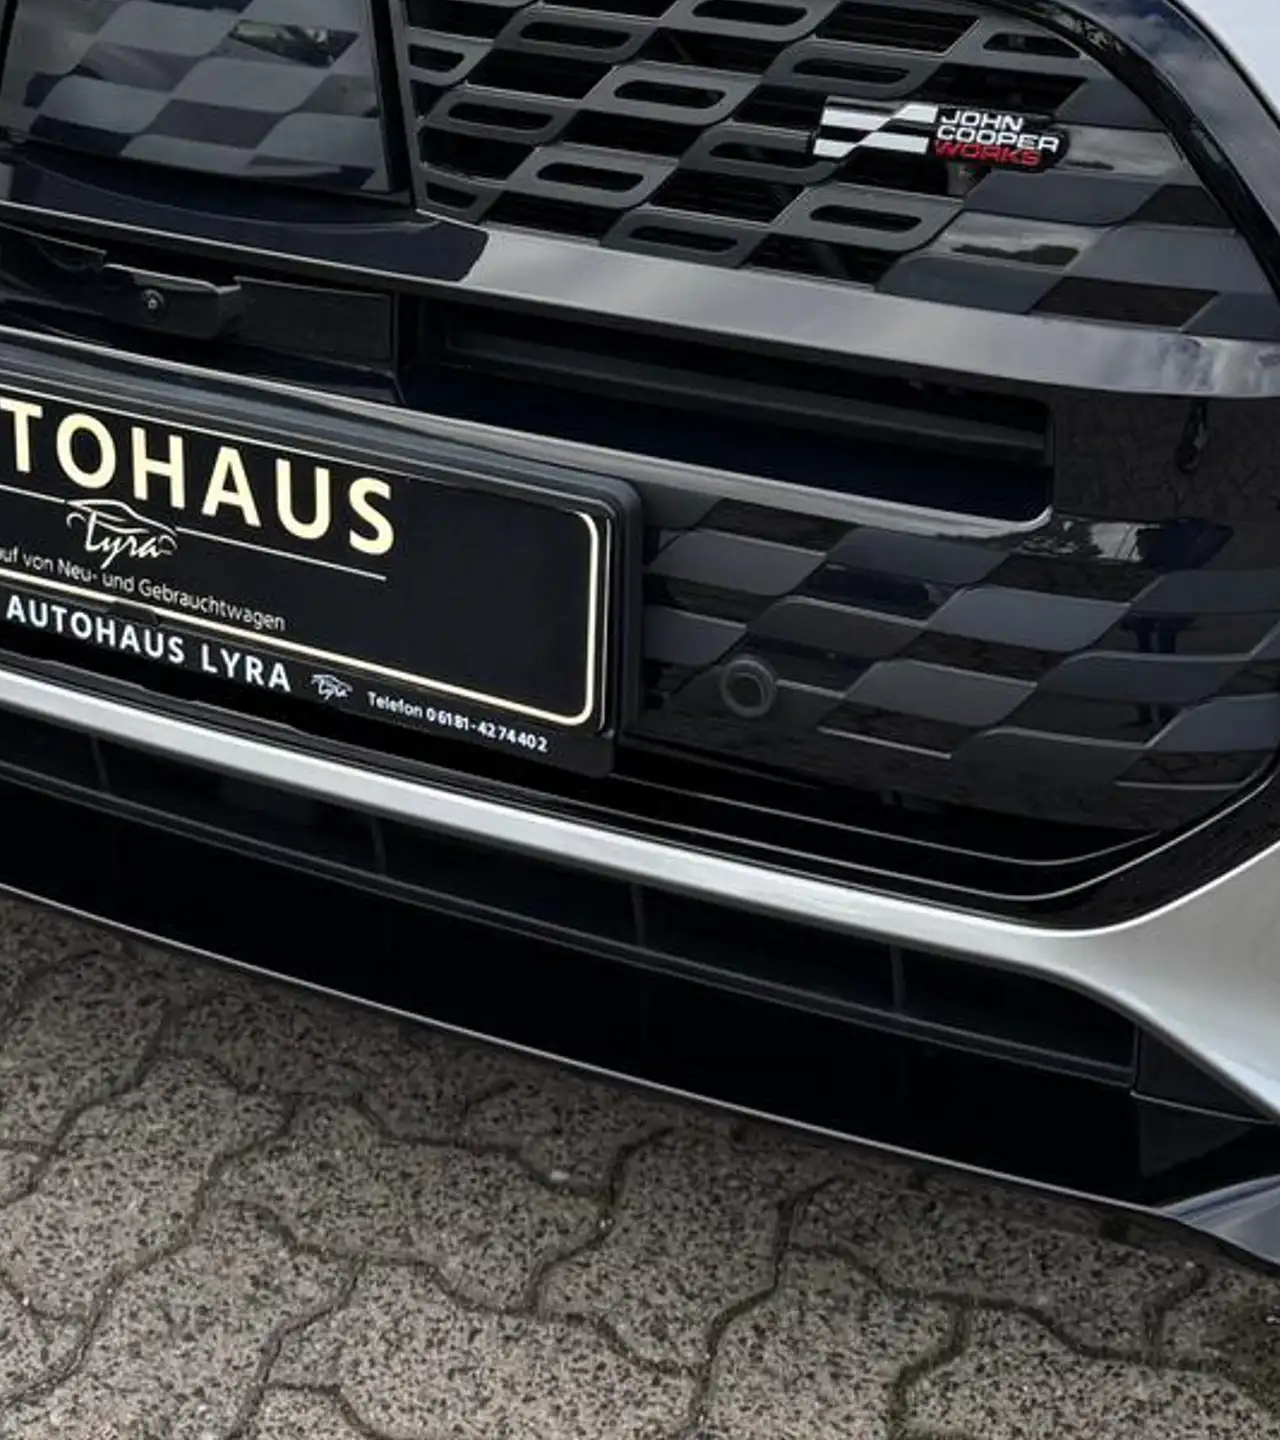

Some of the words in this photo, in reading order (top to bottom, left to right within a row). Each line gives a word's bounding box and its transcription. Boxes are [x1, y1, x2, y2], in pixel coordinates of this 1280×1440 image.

[940, 108, 1024, 132] JOHN
[933, 139, 1044, 167] WORKS
[936, 125, 1061, 154] COOPER
[23, 552, 55, 573] von
[57, 558, 99, 583] Neu-
[103, 568, 136, 593] und
[138, 578, 287, 632] Gebrauchtwagen
[6, 593, 186, 665] AUTOHAUS
[201, 642, 293, 693] LYRA
[367, 690, 423, 720] Telefon
